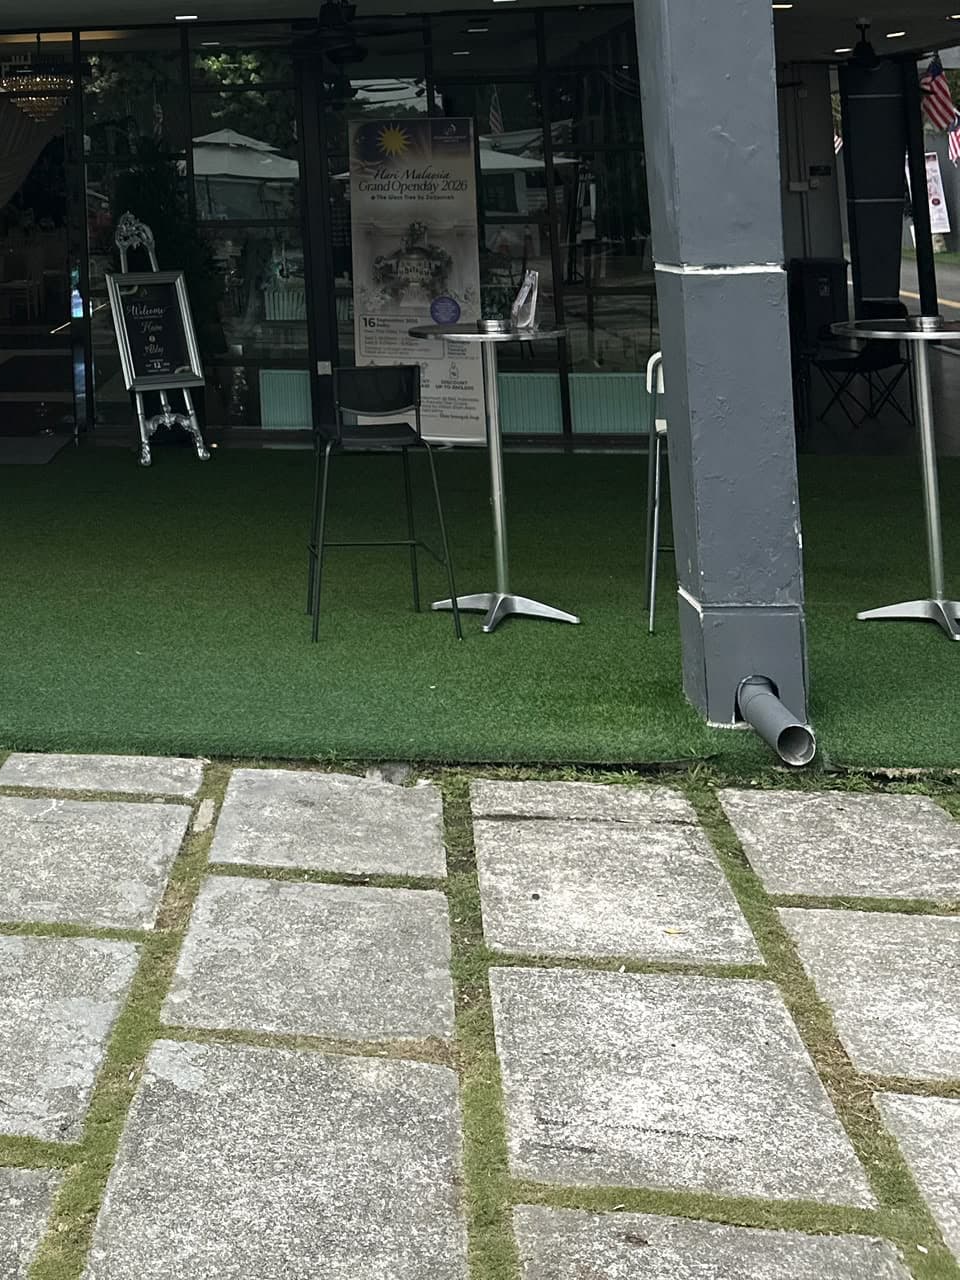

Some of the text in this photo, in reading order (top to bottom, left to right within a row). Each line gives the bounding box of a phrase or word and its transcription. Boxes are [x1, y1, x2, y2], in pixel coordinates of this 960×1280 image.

[373, 165, 451, 180] Hari Malaysia
[358, 181, 390, 192] Grand
[391, 180, 439, 194] Openday
[128, 305, 165, 317] Welcome
[363, 318, 376, 328] 16
